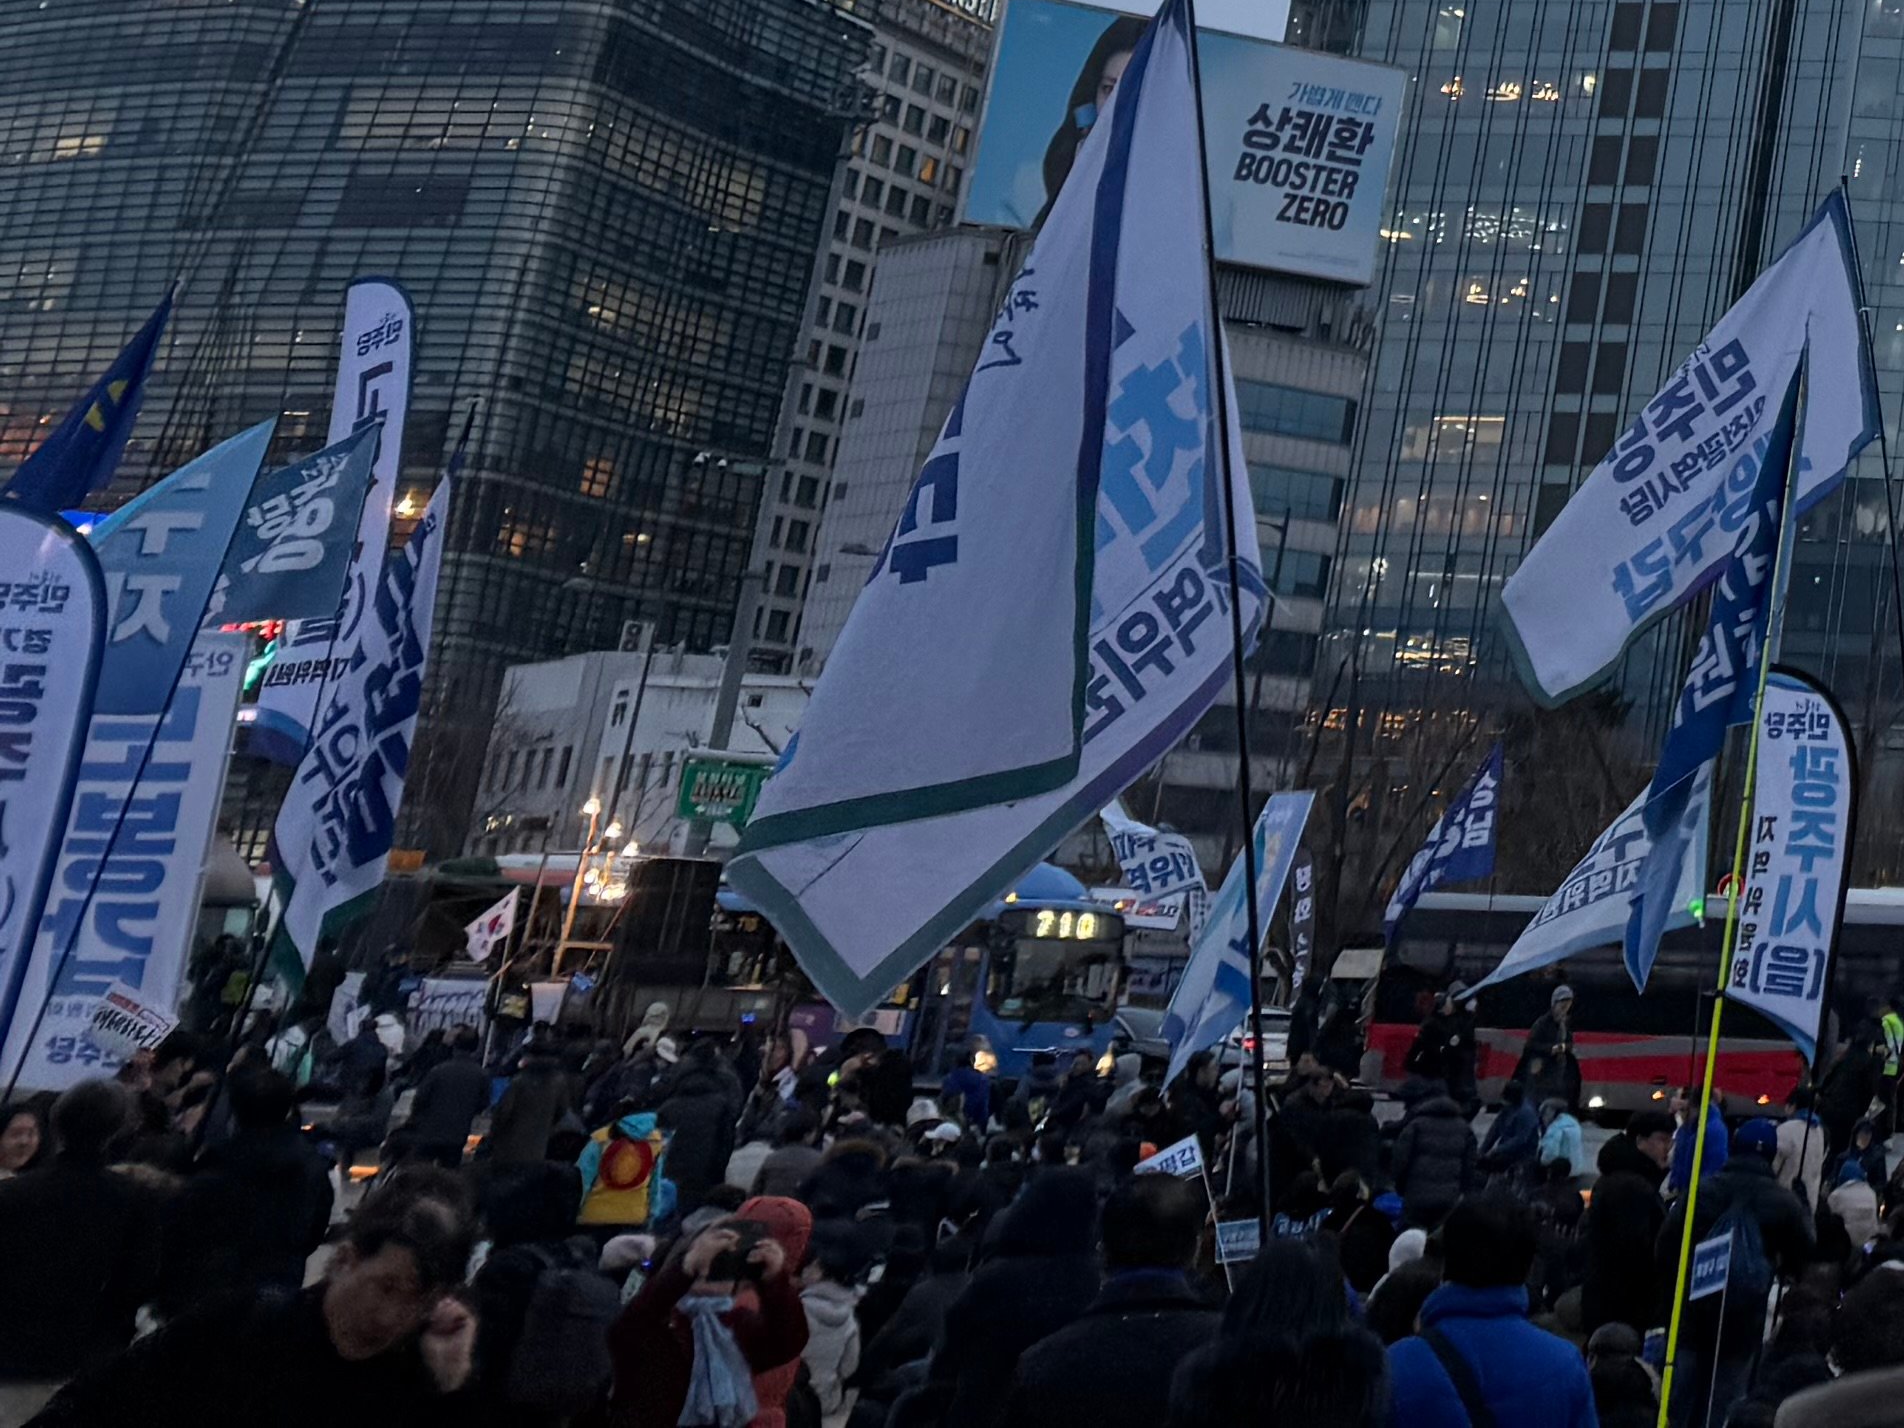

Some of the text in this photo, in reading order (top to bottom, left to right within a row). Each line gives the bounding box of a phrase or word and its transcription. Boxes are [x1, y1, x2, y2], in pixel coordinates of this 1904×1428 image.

[1243, 103, 1375, 167] 상쾌환
[1233, 152, 1360, 200] BOOSTER
[1275, 193, 1349, 231] ZERO
[1036, 909, 1096, 939] 710
